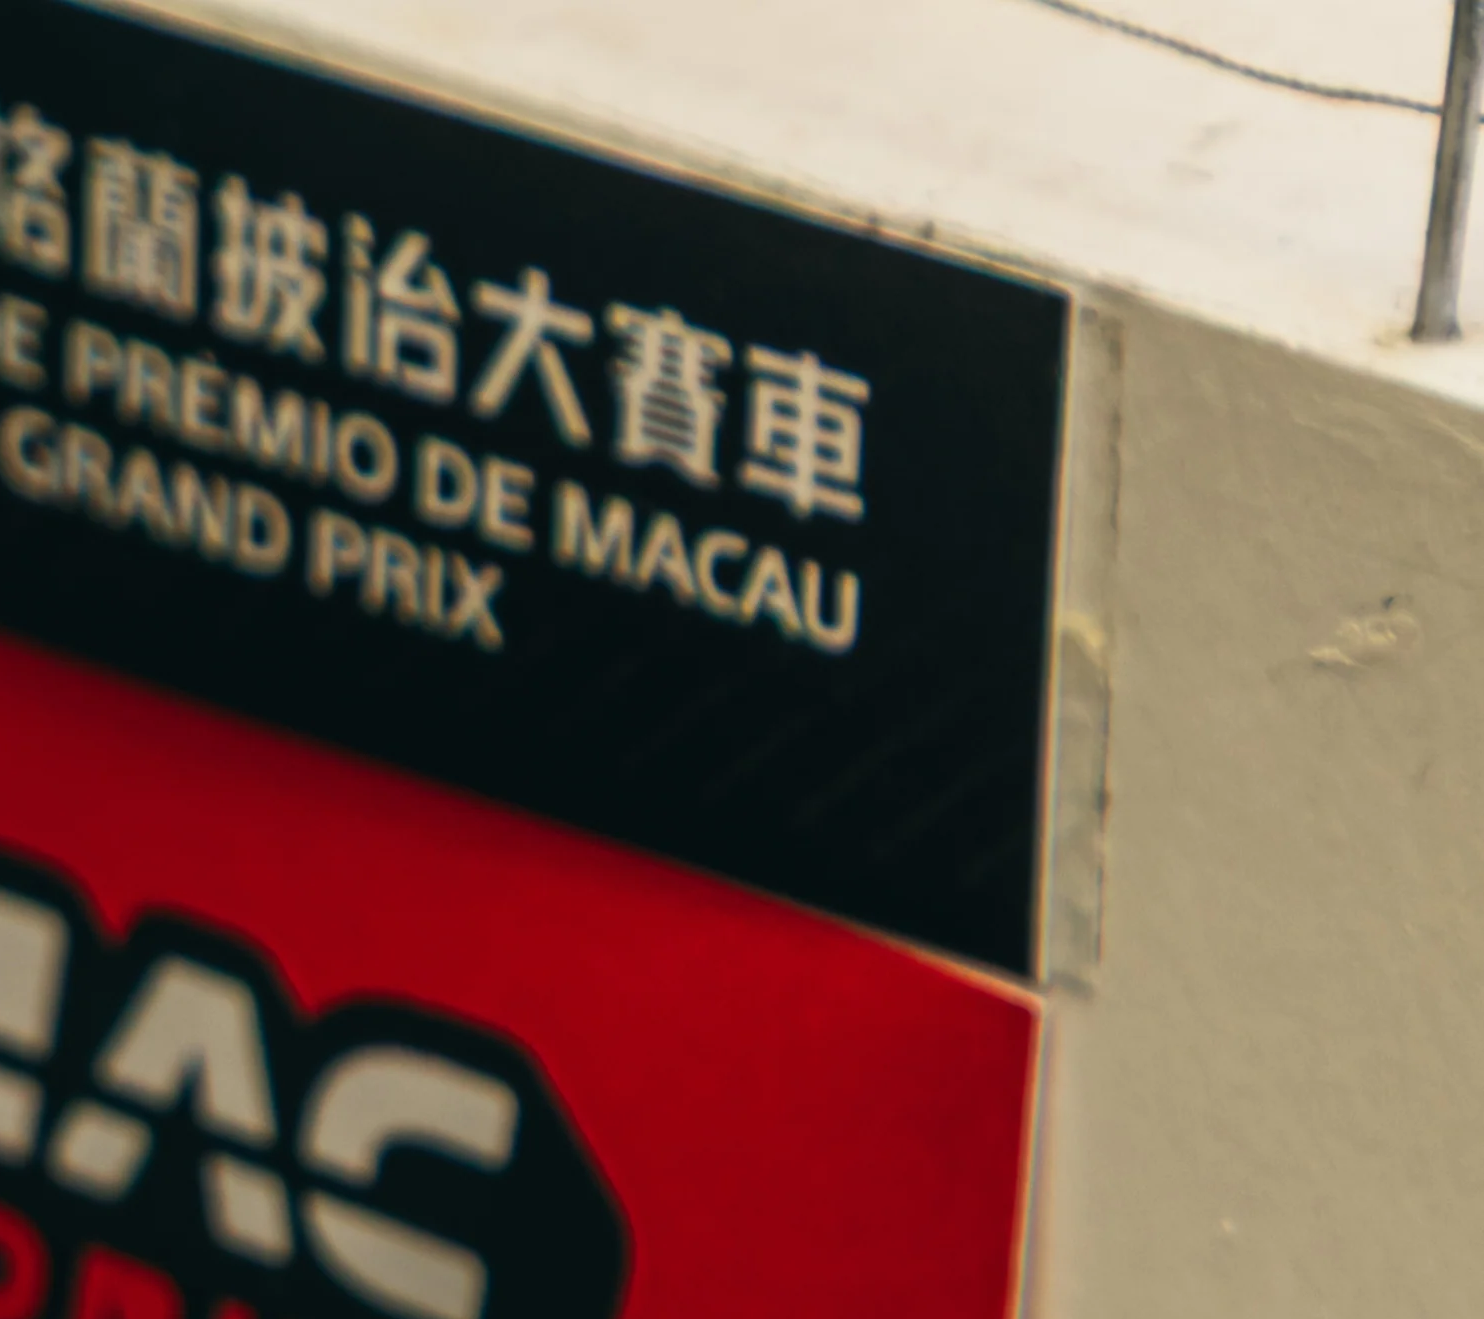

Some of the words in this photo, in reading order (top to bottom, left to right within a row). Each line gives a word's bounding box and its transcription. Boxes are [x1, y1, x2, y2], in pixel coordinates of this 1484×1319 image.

[309, 515, 507, 650] PRIX
[416, 437, 537, 550] DE
[556, 485, 862, 654] MACAU
